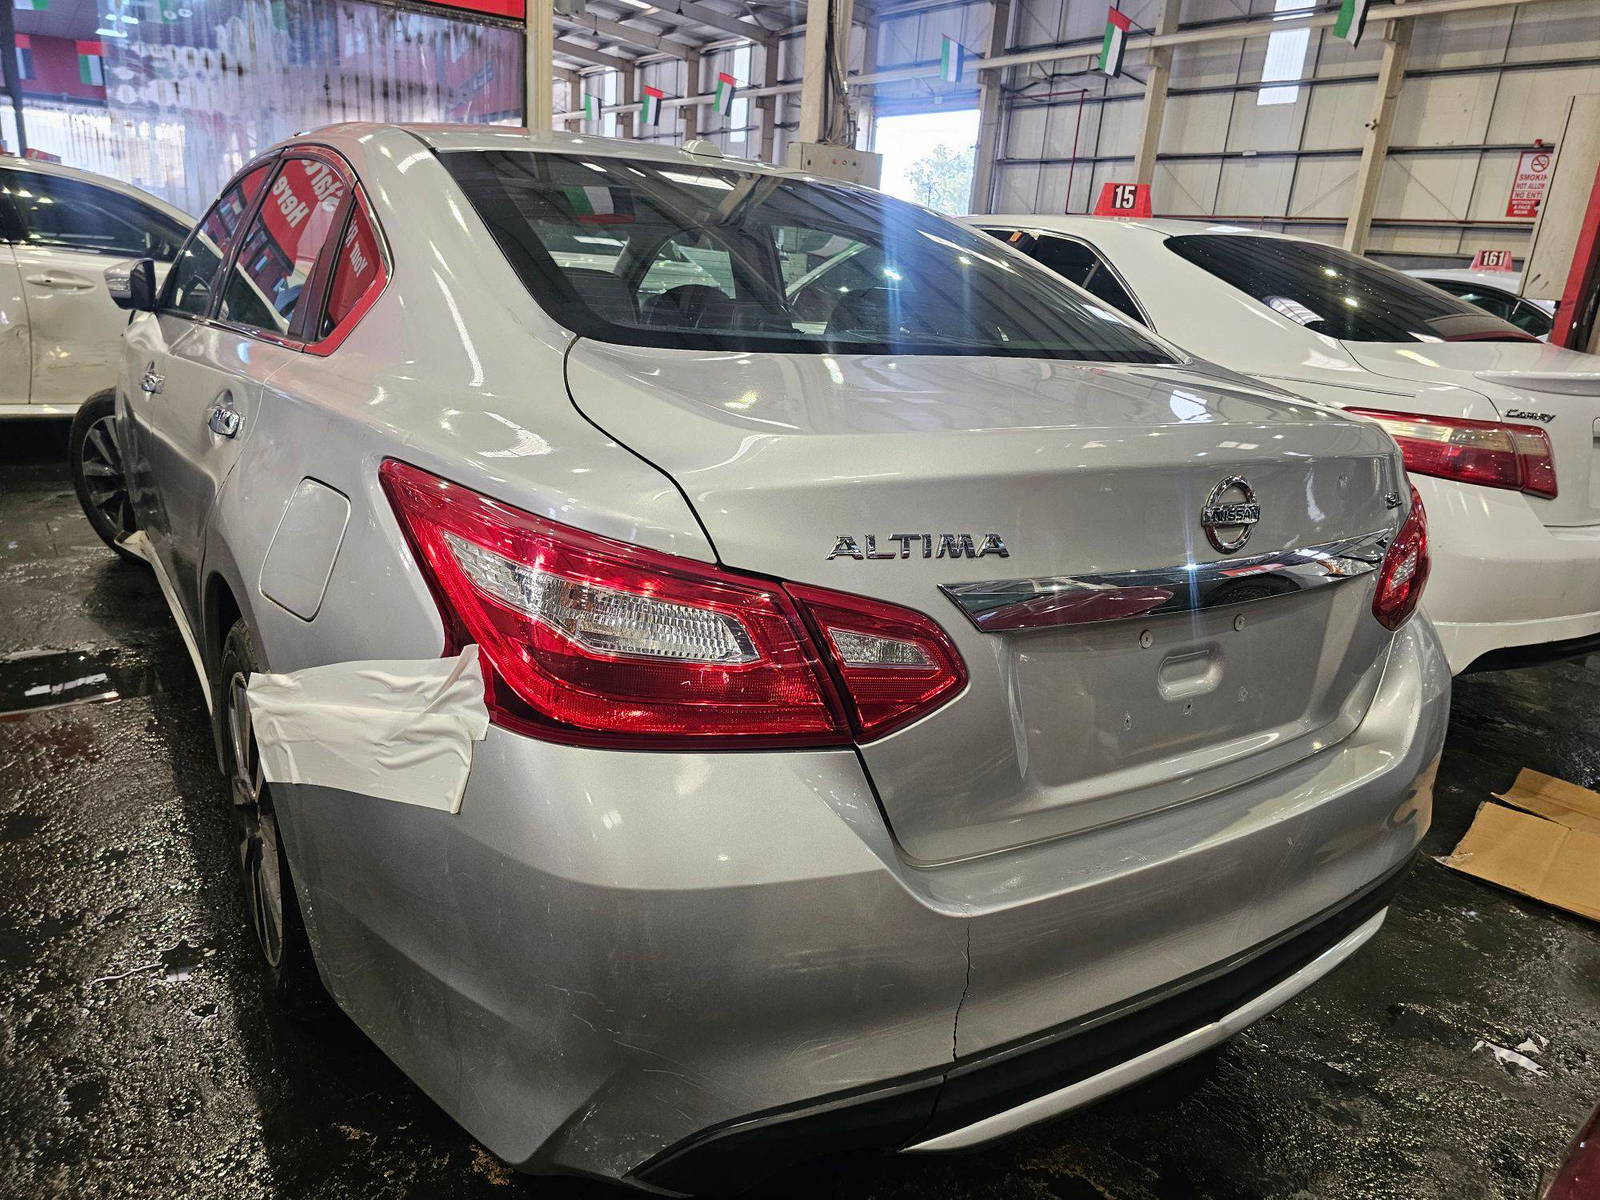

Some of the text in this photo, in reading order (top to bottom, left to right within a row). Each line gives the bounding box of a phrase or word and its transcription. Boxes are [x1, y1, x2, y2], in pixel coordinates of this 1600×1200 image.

[1115, 185, 1136, 209] 15
[1483, 251, 1505, 266] 161
[1505, 409, 1556, 423] Camry
[1212, 505, 1259, 522] NISSAN
[825, 533, 1010, 560] ALTIMA
